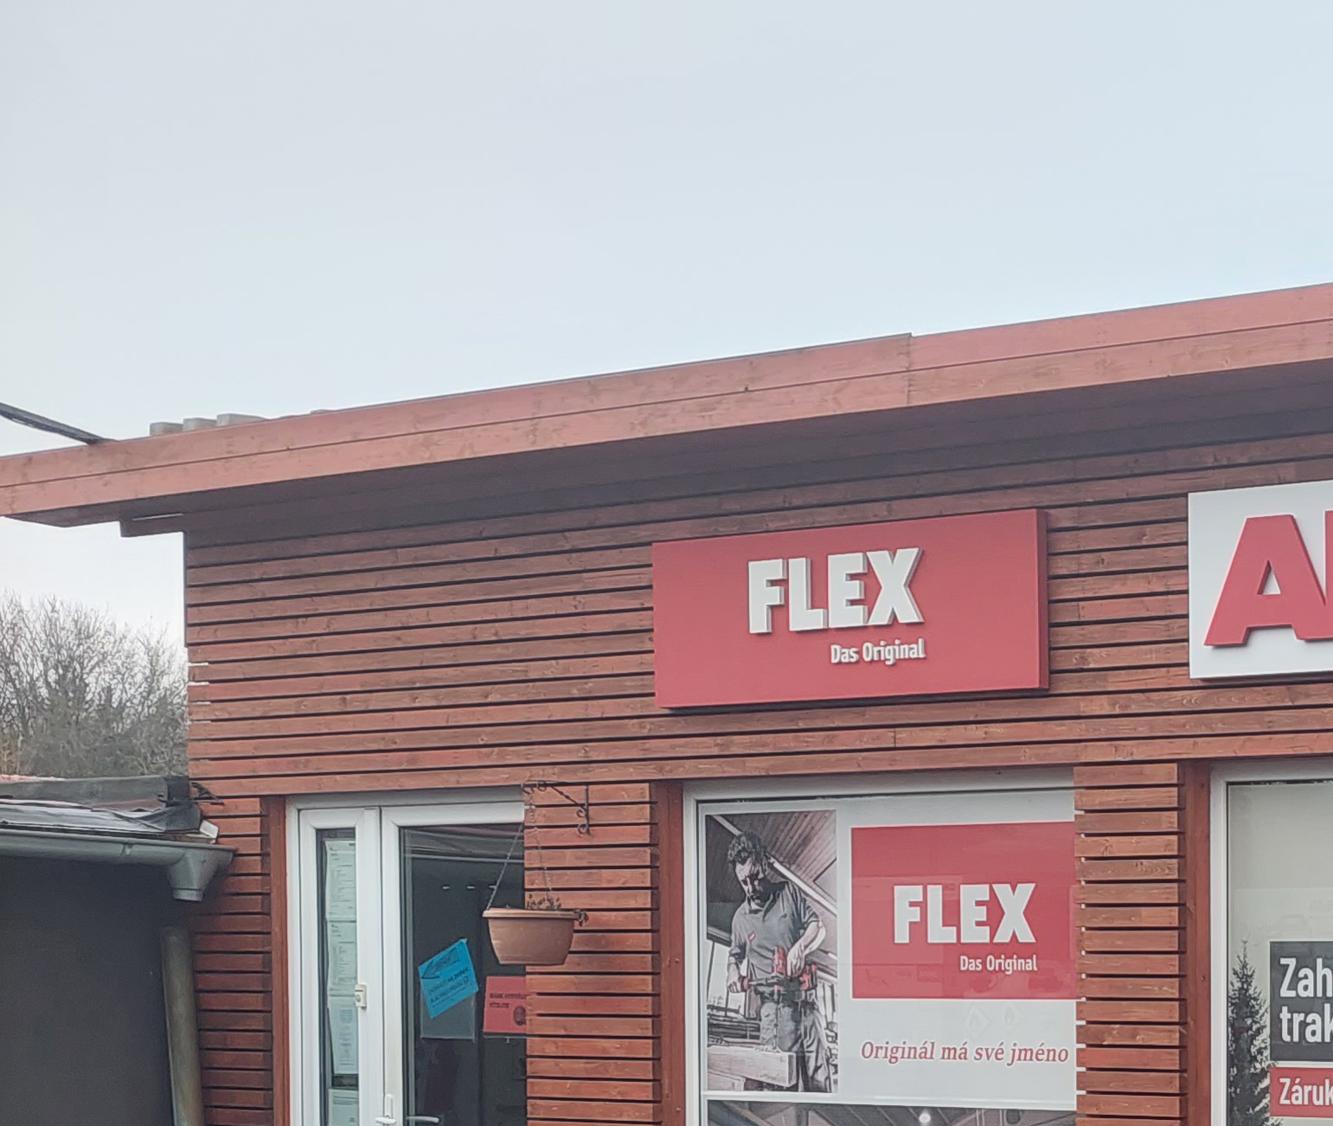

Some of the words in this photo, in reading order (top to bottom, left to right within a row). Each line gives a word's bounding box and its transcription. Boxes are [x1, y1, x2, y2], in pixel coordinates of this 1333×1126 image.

[747, 546, 924, 635] FLEX
[830, 643, 859, 664] Das
[862, 638, 926, 665] Original
[893, 882, 1037, 945] FLEX
[959, 956, 983, 972] Das
[986, 953, 1038, 974] Original
[861, 1040, 935, 1065] Originál
[941, 1041, 968, 1062] má
[973, 1043, 1005, 1062] své
[1007, 1043, 1069, 1066] jméno
